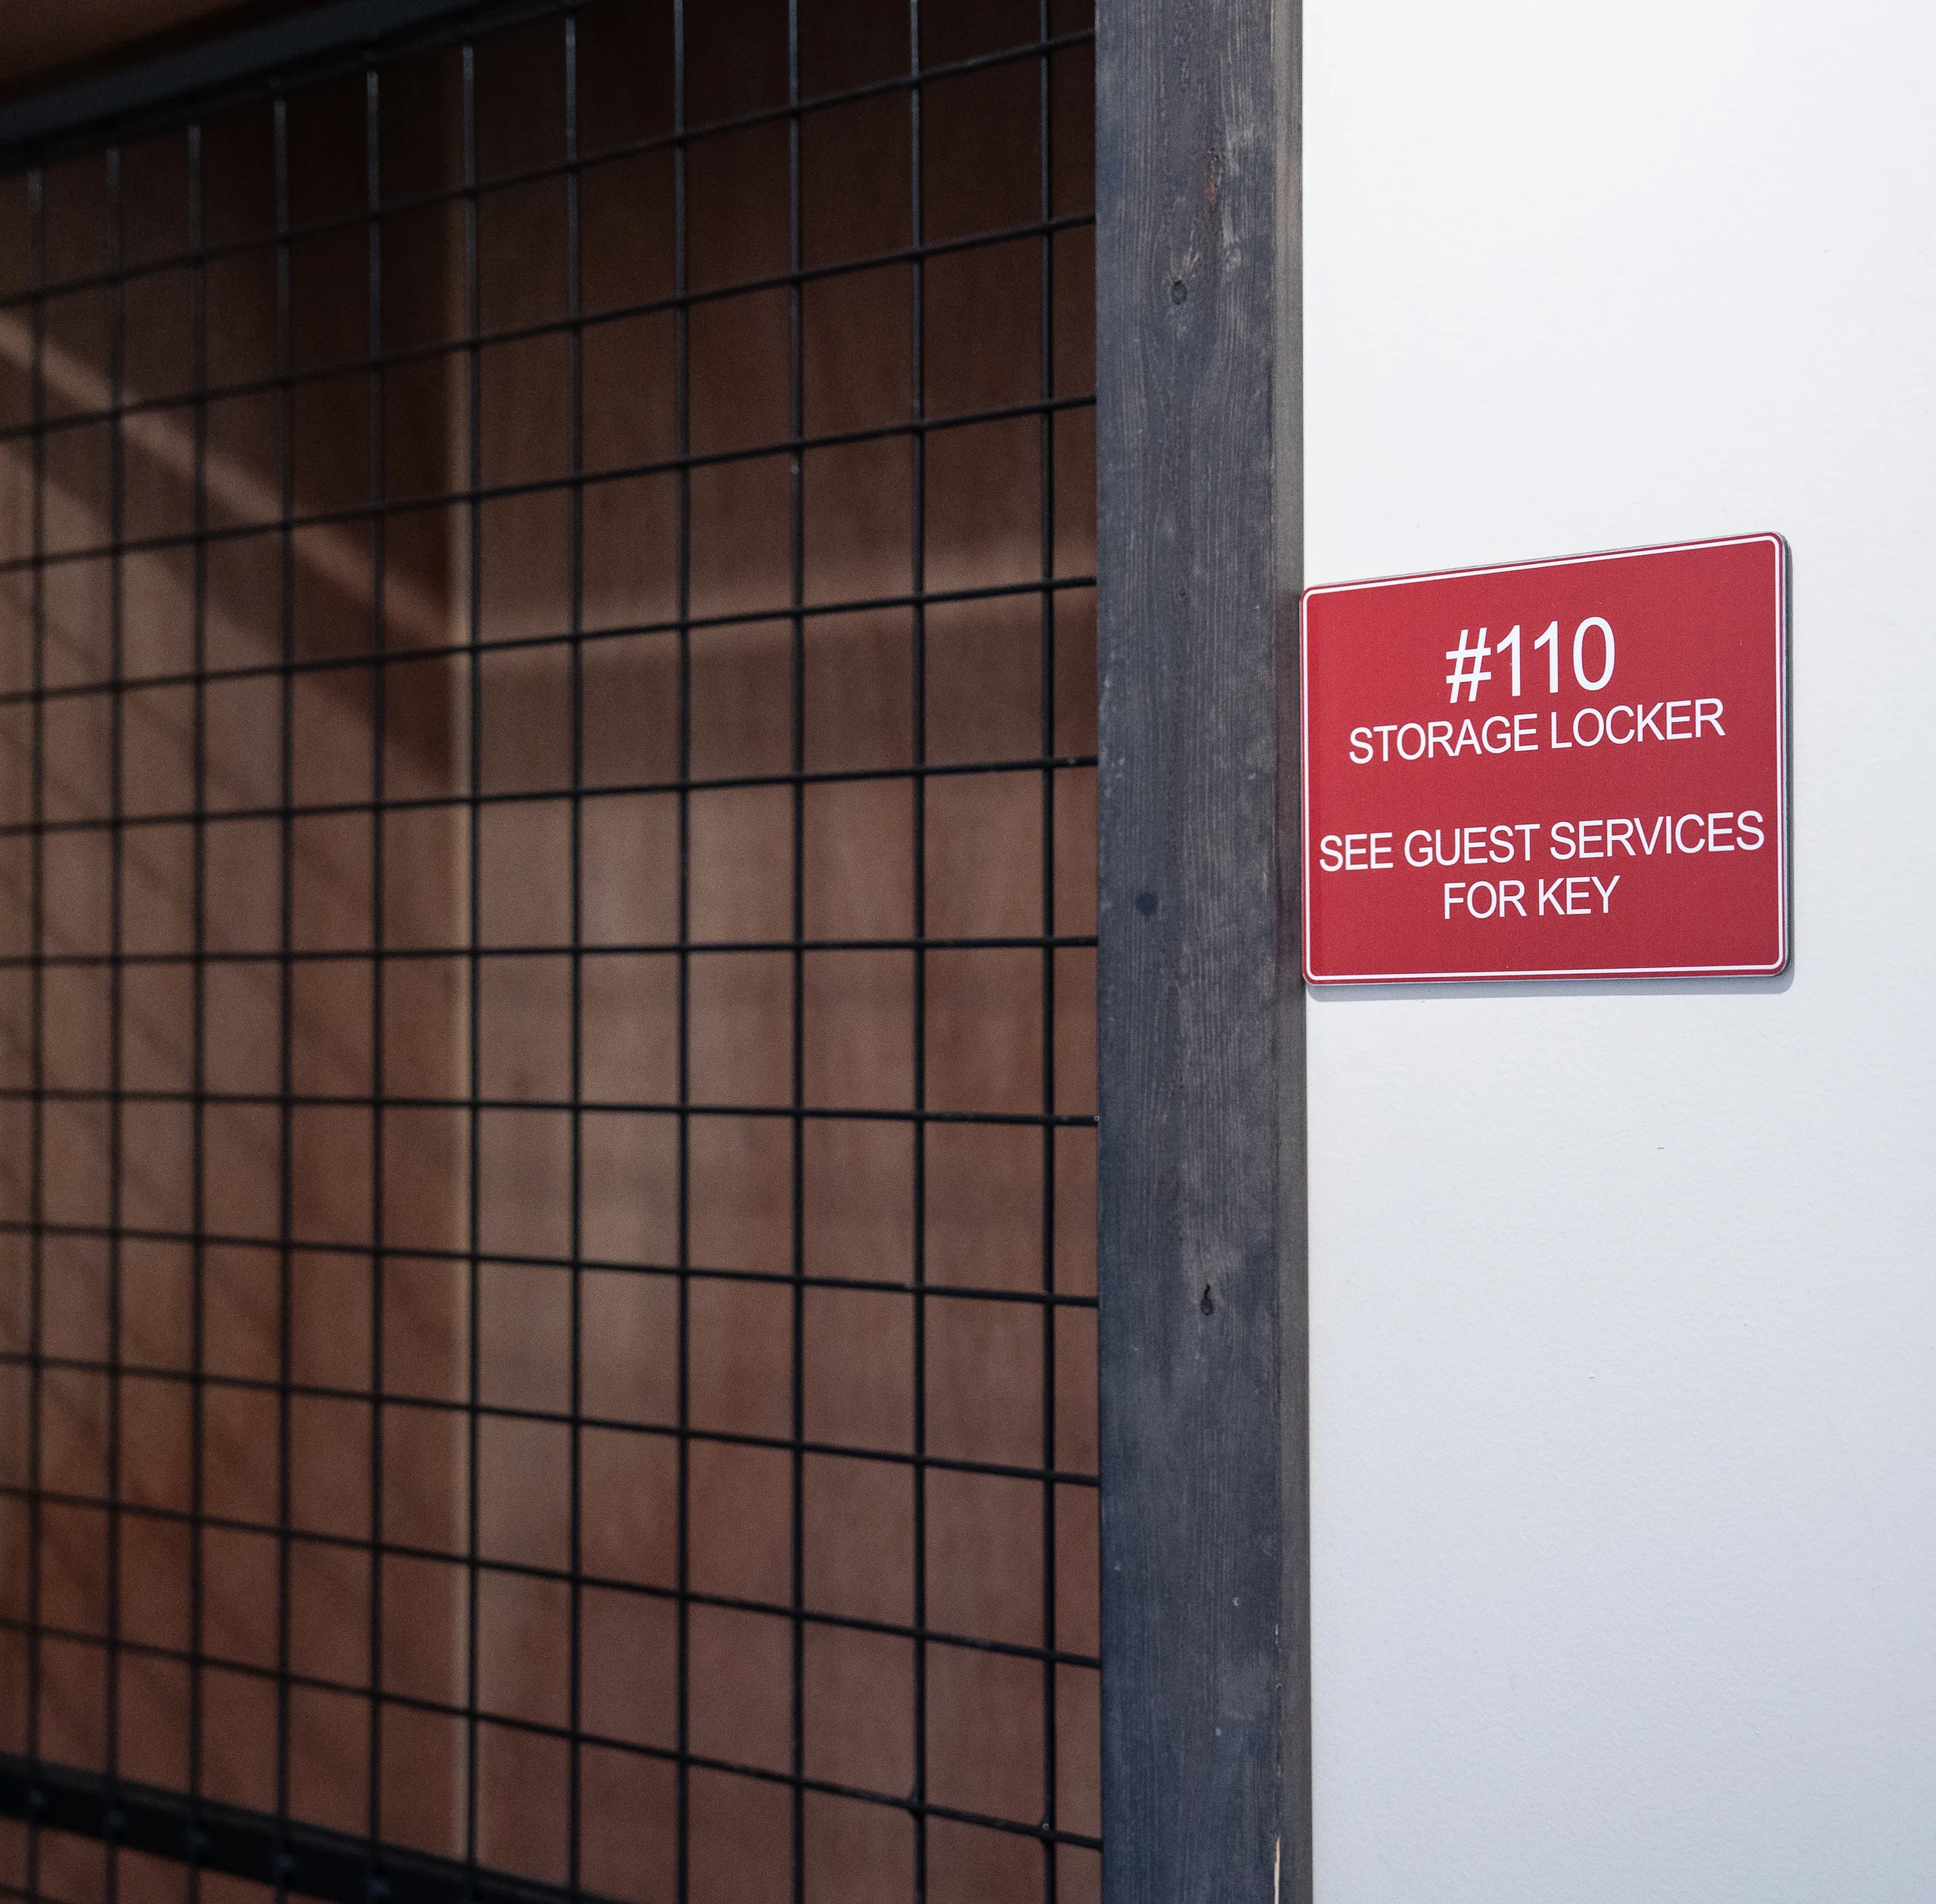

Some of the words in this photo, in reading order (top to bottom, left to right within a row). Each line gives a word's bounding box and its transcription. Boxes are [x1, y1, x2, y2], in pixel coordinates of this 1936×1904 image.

[1445, 616, 1615, 704] #110
[1348, 713, 1539, 764] STORAGE
[1550, 697, 1727, 749] LOCKER
[1319, 833, 1394, 873] SEE
[1404, 823, 1540, 867] GUEST
[1550, 810, 1765, 861] SERVICES
[1444, 879, 1528, 919] FOR
[1538, 875, 1621, 916] KEY
